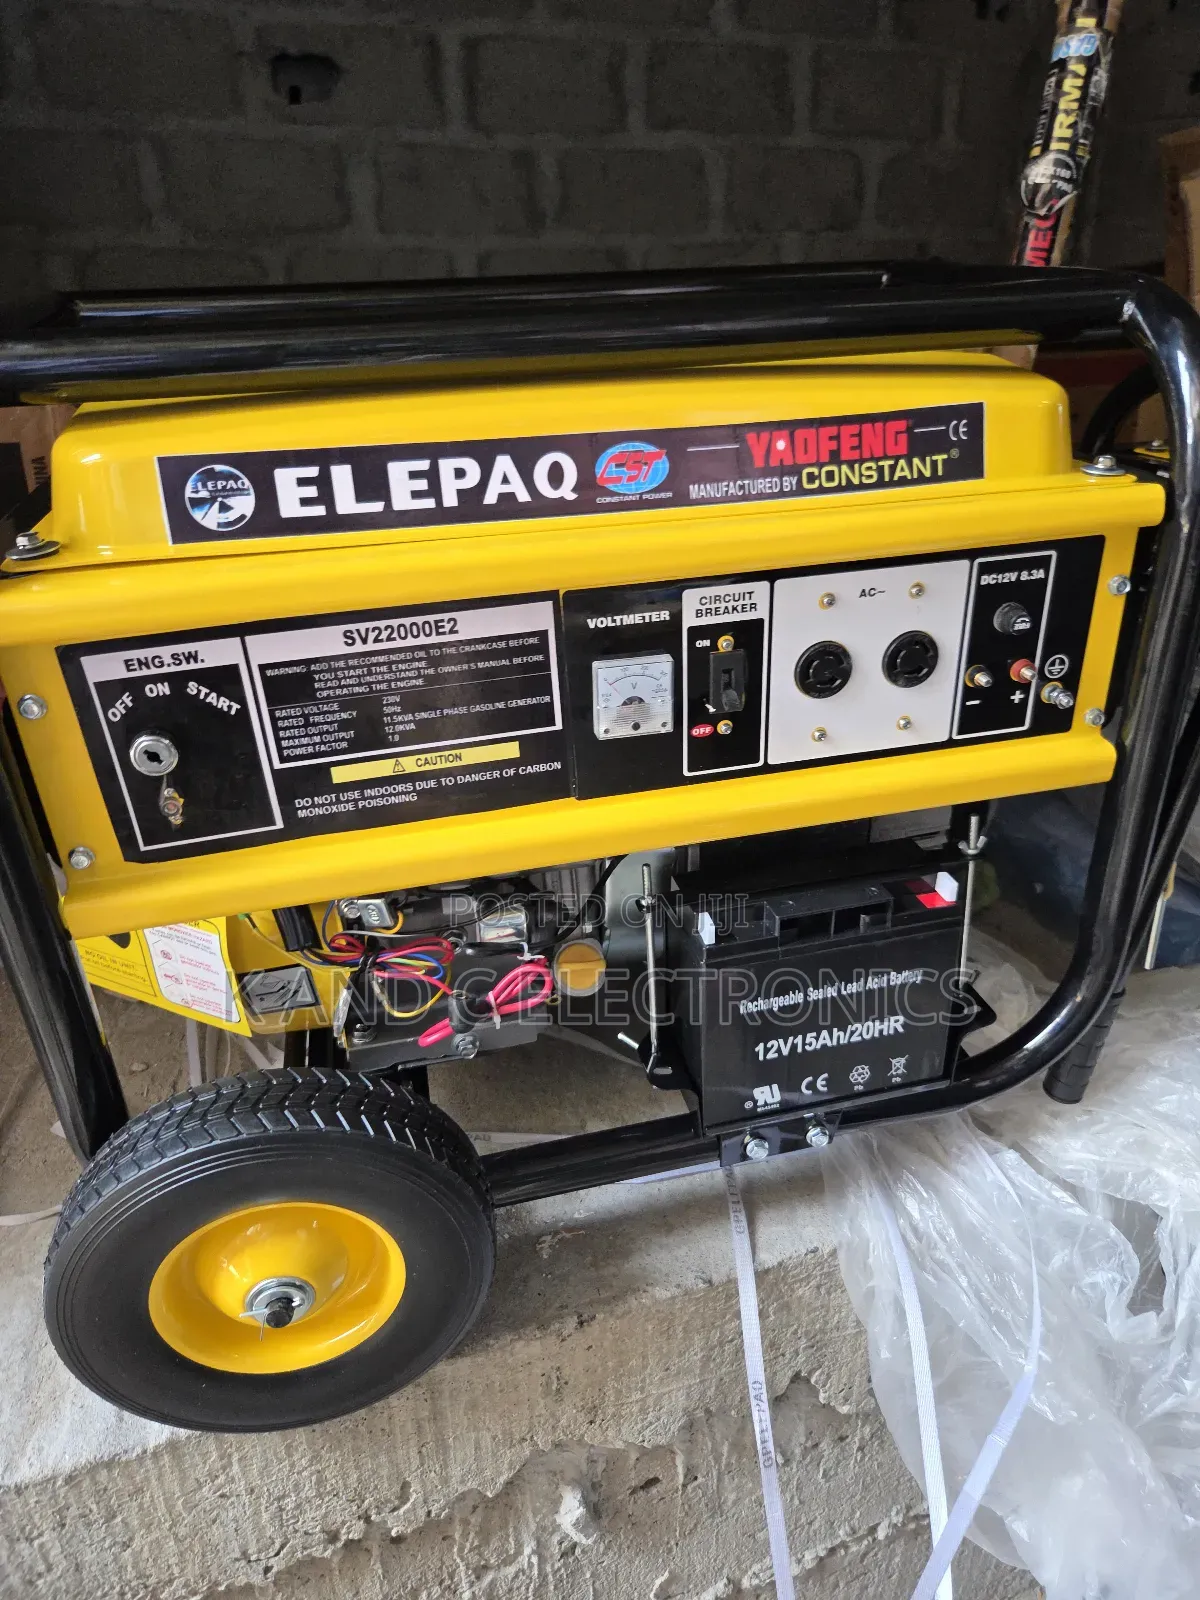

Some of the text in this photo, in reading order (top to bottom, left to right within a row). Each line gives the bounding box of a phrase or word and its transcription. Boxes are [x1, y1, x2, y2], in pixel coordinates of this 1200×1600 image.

[746, 419, 909, 468] YAOFENG
[595, 448, 667, 487] CST
[802, 455, 949, 490] CONSTANT
[274, 451, 578, 519] ELEPAQ
[689, 476, 799, 500] MANUFACTURED BY
[596, 492, 673, 503] CONSTANT POWER
[980, 569, 1045, 585] DC12V 8.3A
[695, 602, 757, 618] BREAKER
[699, 591, 755, 606] CIRCUIT
[587, 610, 670, 629] VOLTMETER
[343, 618, 459, 647] SV22000E2
[696, 639, 711, 648] ON
[124, 650, 205, 673] ENG.SW.
[310, 663, 329, 671] ADD
[330, 661, 346, 669] THE
[348, 651, 413, 666] RECOMMENDED
[429, 649, 440, 657] TO
[442, 647, 457, 655] THE
[459, 641, 507, 653] CRANKCASE
[509, 637, 540, 647] BEFORE
[313, 670, 335, 681] YOU
[337, 668, 368, 678] START
[314, 654, 545, 689] READ AND UNDERSTAND THE OWNER'S MANUAL BEFORE
[145, 682, 170, 698] ON
[186, 682, 241, 716] START
[316, 683, 370, 698] OPERATING
[372, 682, 390, 691] THE
[108, 692, 134, 723] OFF
[275, 707, 302, 718] RATED
[304, 703, 340, 715] VOLTAGE
[279, 728, 306, 738] RATED
[307, 723, 339, 734] OUTPUT
[414, 709, 442, 720] SINGLE
[443, 706, 468, 716] PHASE
[470, 701, 506, 713] GASOLINE
[508, 696, 551, 708] GENERATOR
[277, 718, 305, 728] RATED
[309, 711, 357, 724] FREQUENCY
[692, 726, 712, 736] OFF
[281, 736, 321, 748] MAXIMUM
[322, 731, 355, 742] OUTPUT
[283, 746, 314, 757] POWER
[315, 742, 349, 752] FACTOR
[415, 752, 462, 768] CAUTION
[295, 761, 561, 808] DO NOT USE INDOORS DUE TO DANGER OF CARBON
[297, 793, 417, 818] MONOXIDE POISONING
[739, 968, 923, 1014] Rechargeable Sealed Lead Acid Battery
[754, 1015, 905, 1061] 12V15Ah/20HR
